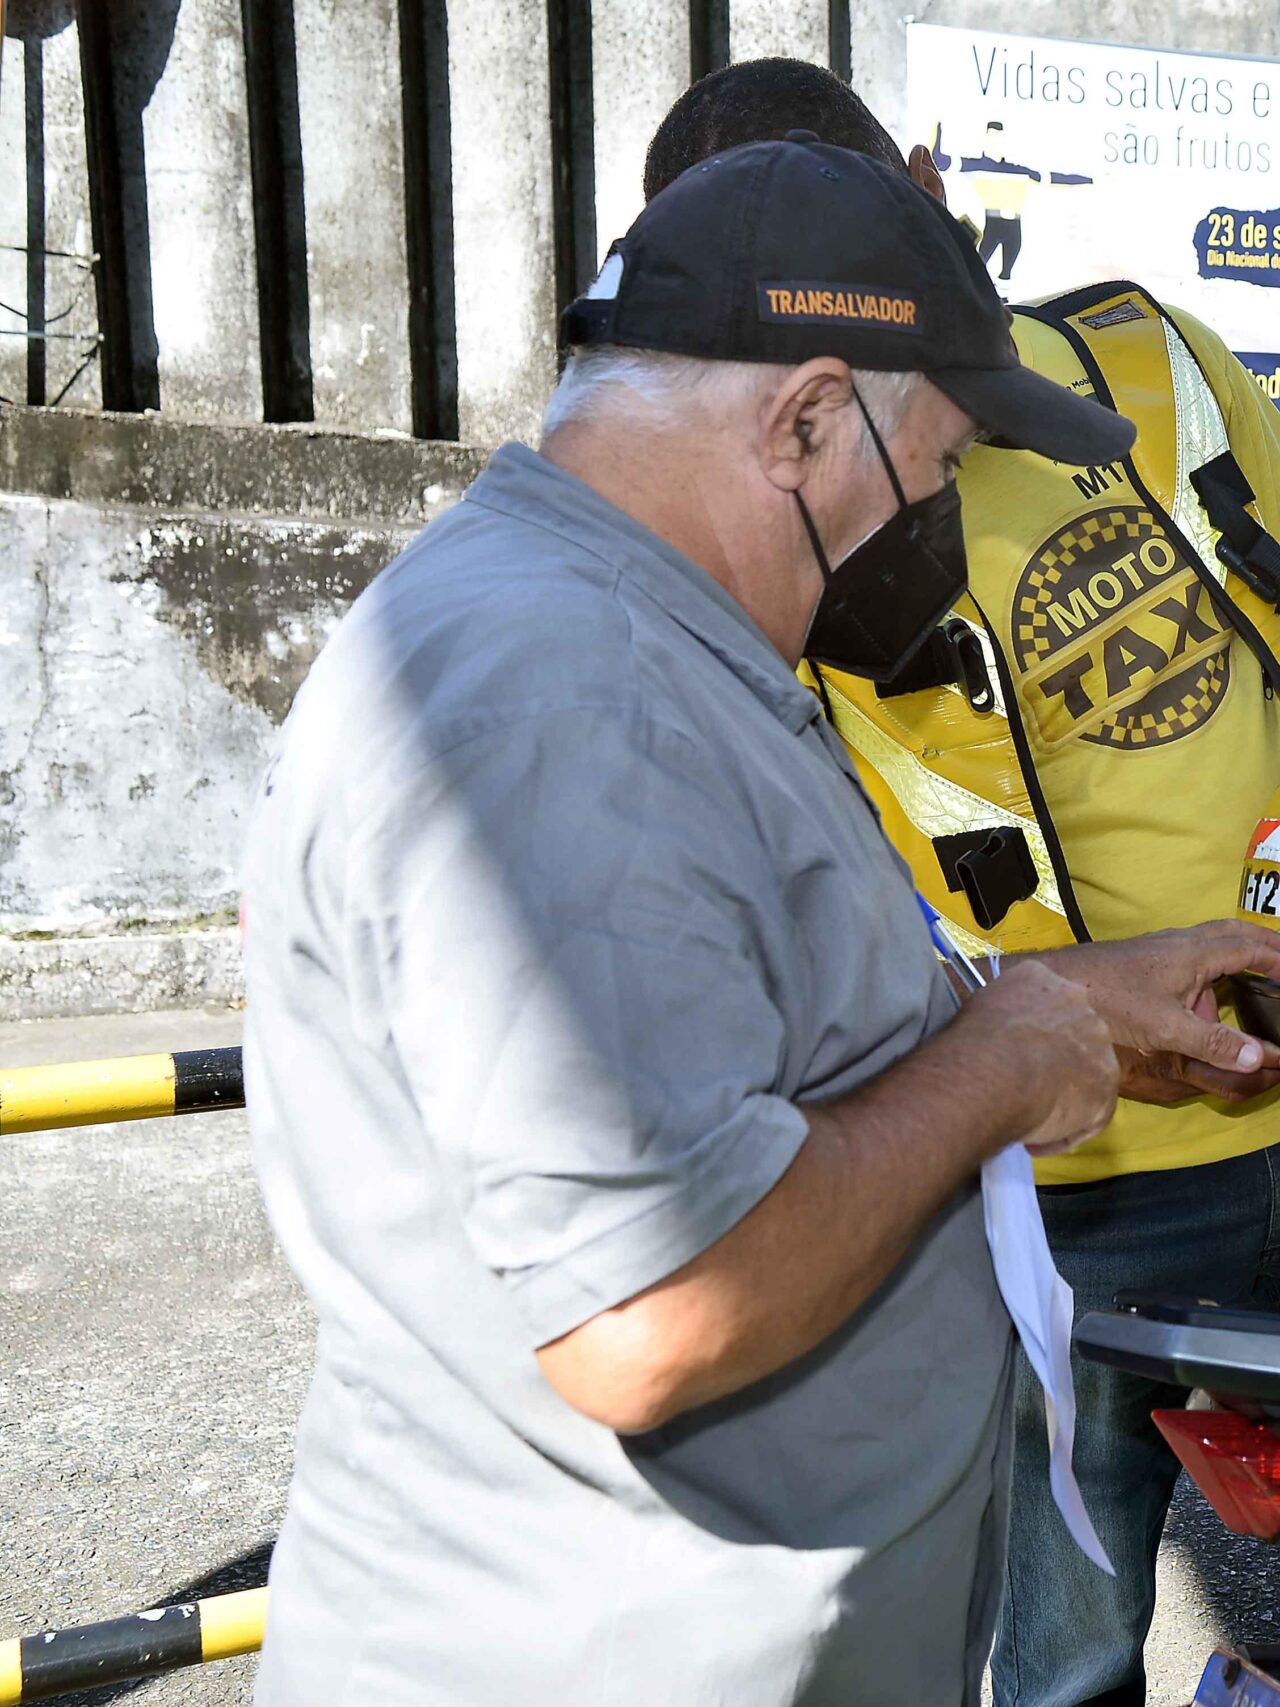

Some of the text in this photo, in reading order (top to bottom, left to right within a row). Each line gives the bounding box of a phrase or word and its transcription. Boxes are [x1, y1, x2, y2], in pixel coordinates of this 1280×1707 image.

[973, 45, 1085, 104] Vidas
[1105, 60, 1233, 116] salvas
[1253, 82, 1270, 118] e
[1104, 123, 1159, 166] são
[1175, 126, 1271, 173] frutos
[1207, 213, 1235, 247] 23
[1240, 216, 1267, 249] de
[1207, 249, 1224, 266] Dia
[1226, 250, 1270, 269] Nacional
[766, 289, 916, 326] TRANSALVADOR
[1046, 537, 1176, 637] MOTO
